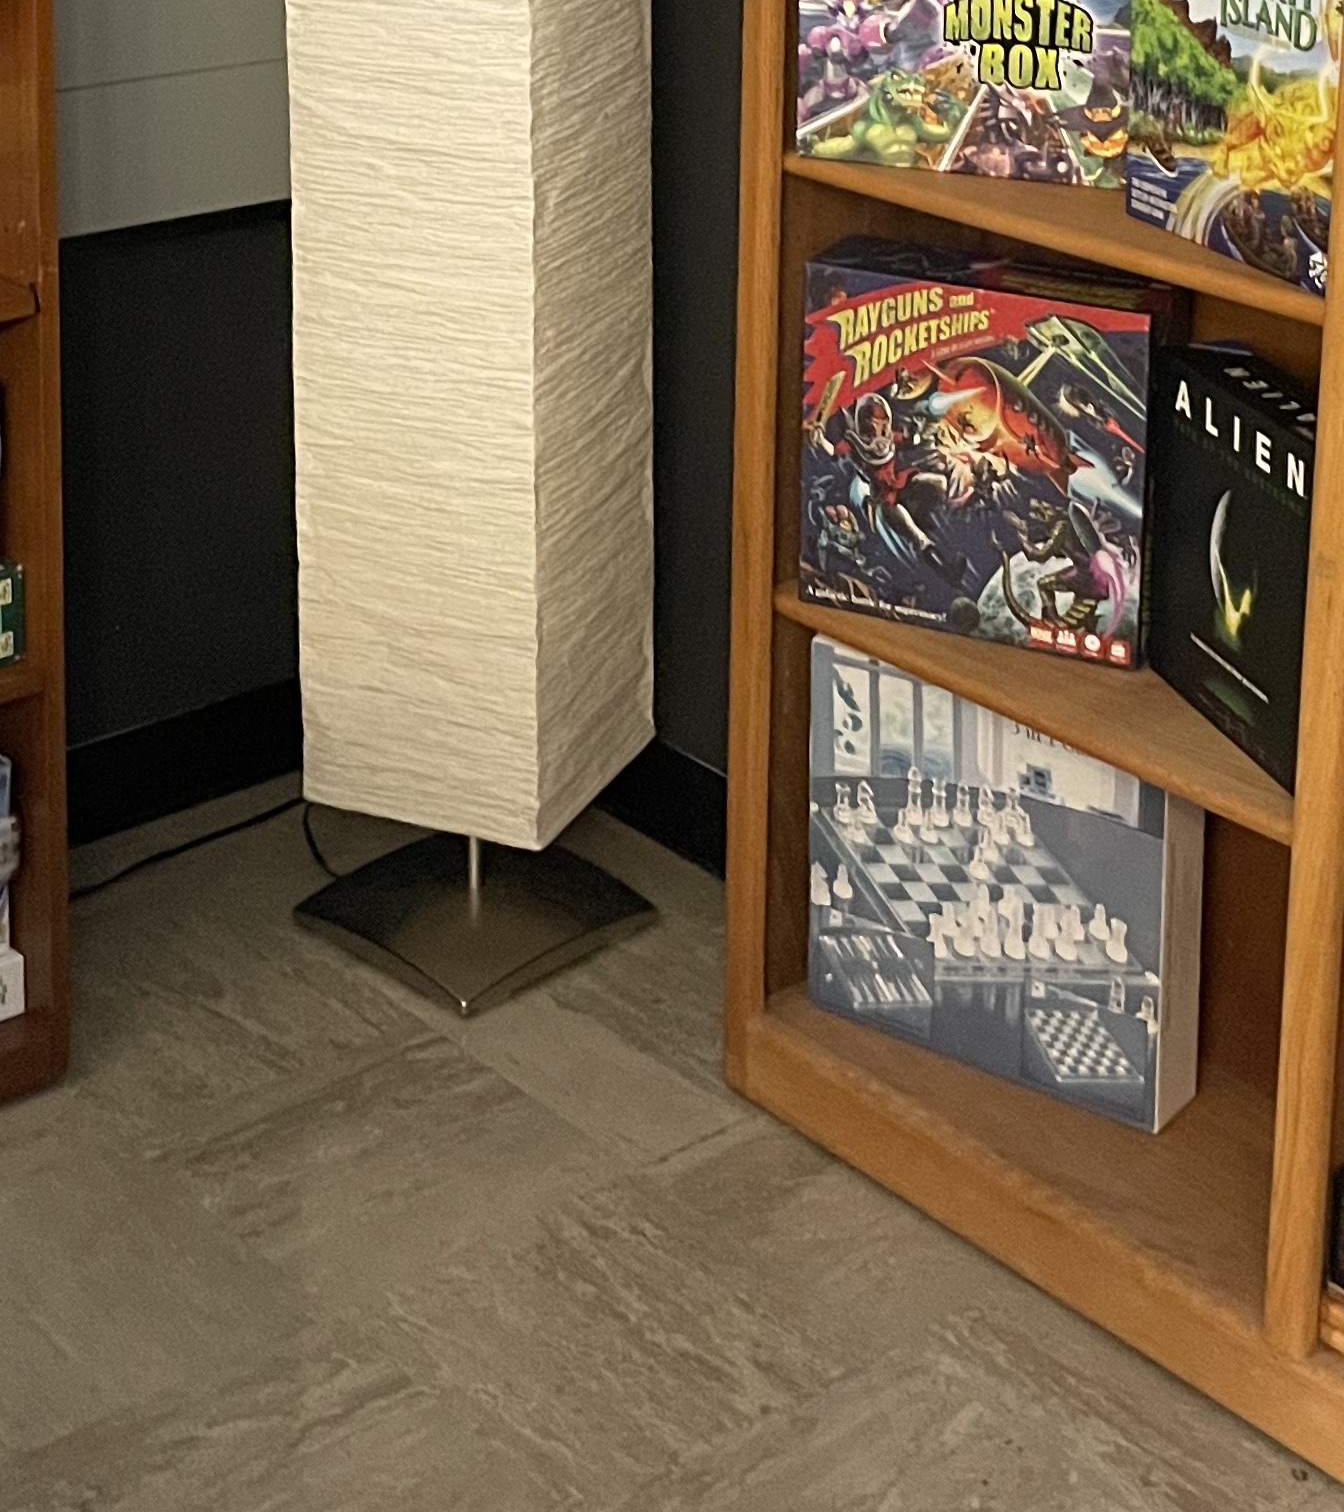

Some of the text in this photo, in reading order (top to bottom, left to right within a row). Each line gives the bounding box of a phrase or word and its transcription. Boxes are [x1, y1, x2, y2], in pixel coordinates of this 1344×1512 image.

[979, 42, 1061, 90] BOX
[828, 286, 975, 346] RAYGUNS and
[845, 308, 990, 388] ROCKETSHIPS
[1174, 380, 1306, 498] ALIEN
